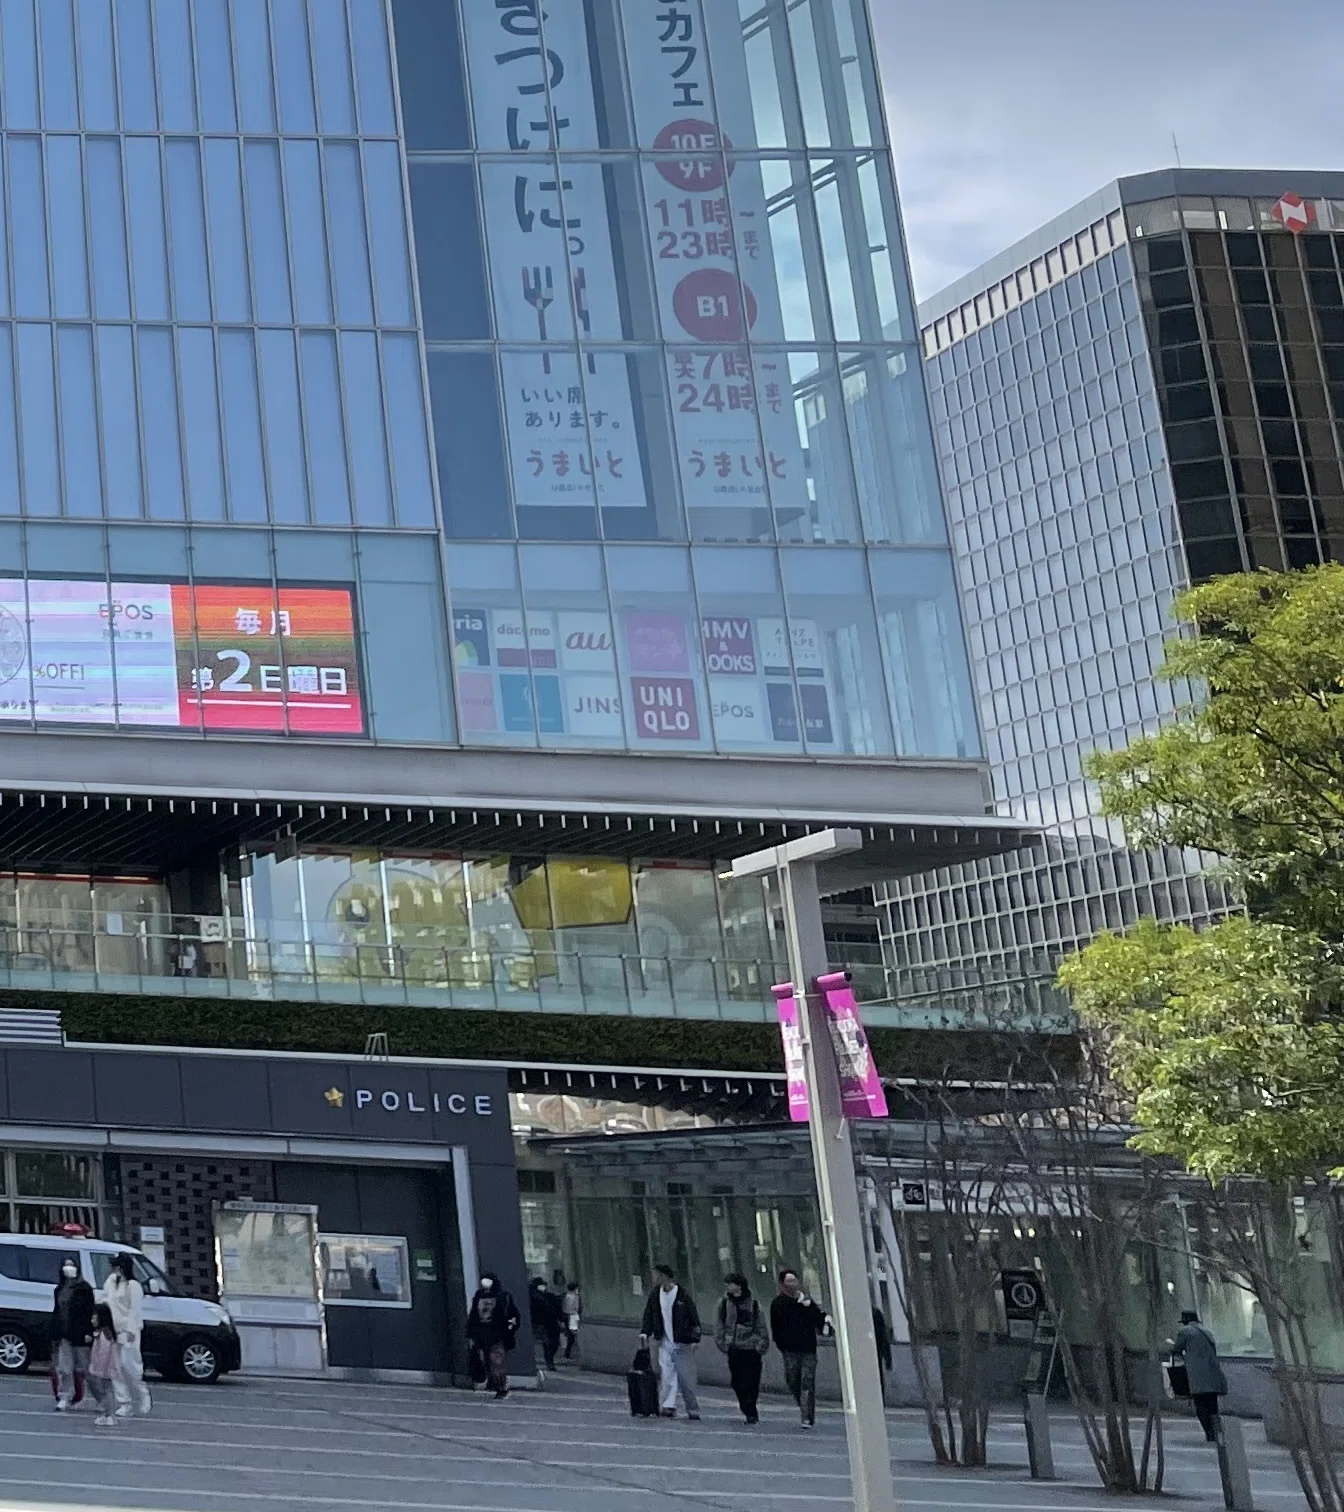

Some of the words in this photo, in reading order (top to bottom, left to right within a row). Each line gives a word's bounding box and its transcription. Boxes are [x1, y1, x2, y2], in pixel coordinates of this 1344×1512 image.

[696, 296, 730, 317] B1
[525, 410, 620, 429] あります。
[526, 450, 623, 478] うまいと
[688, 449, 787, 479] うまいと
[98, 600, 154, 620] EPOS
[234, 607, 292, 637] 毎月
[497, 624, 551, 637] docmo
[565, 631, 612, 651] au
[191, 648, 348, 696] 第2日曜日
[708, 653, 755, 673] OOKS
[639, 686, 683, 708] UNI
[643, 709, 691, 734] QLO
[356, 1089, 493, 1116] POLICE
